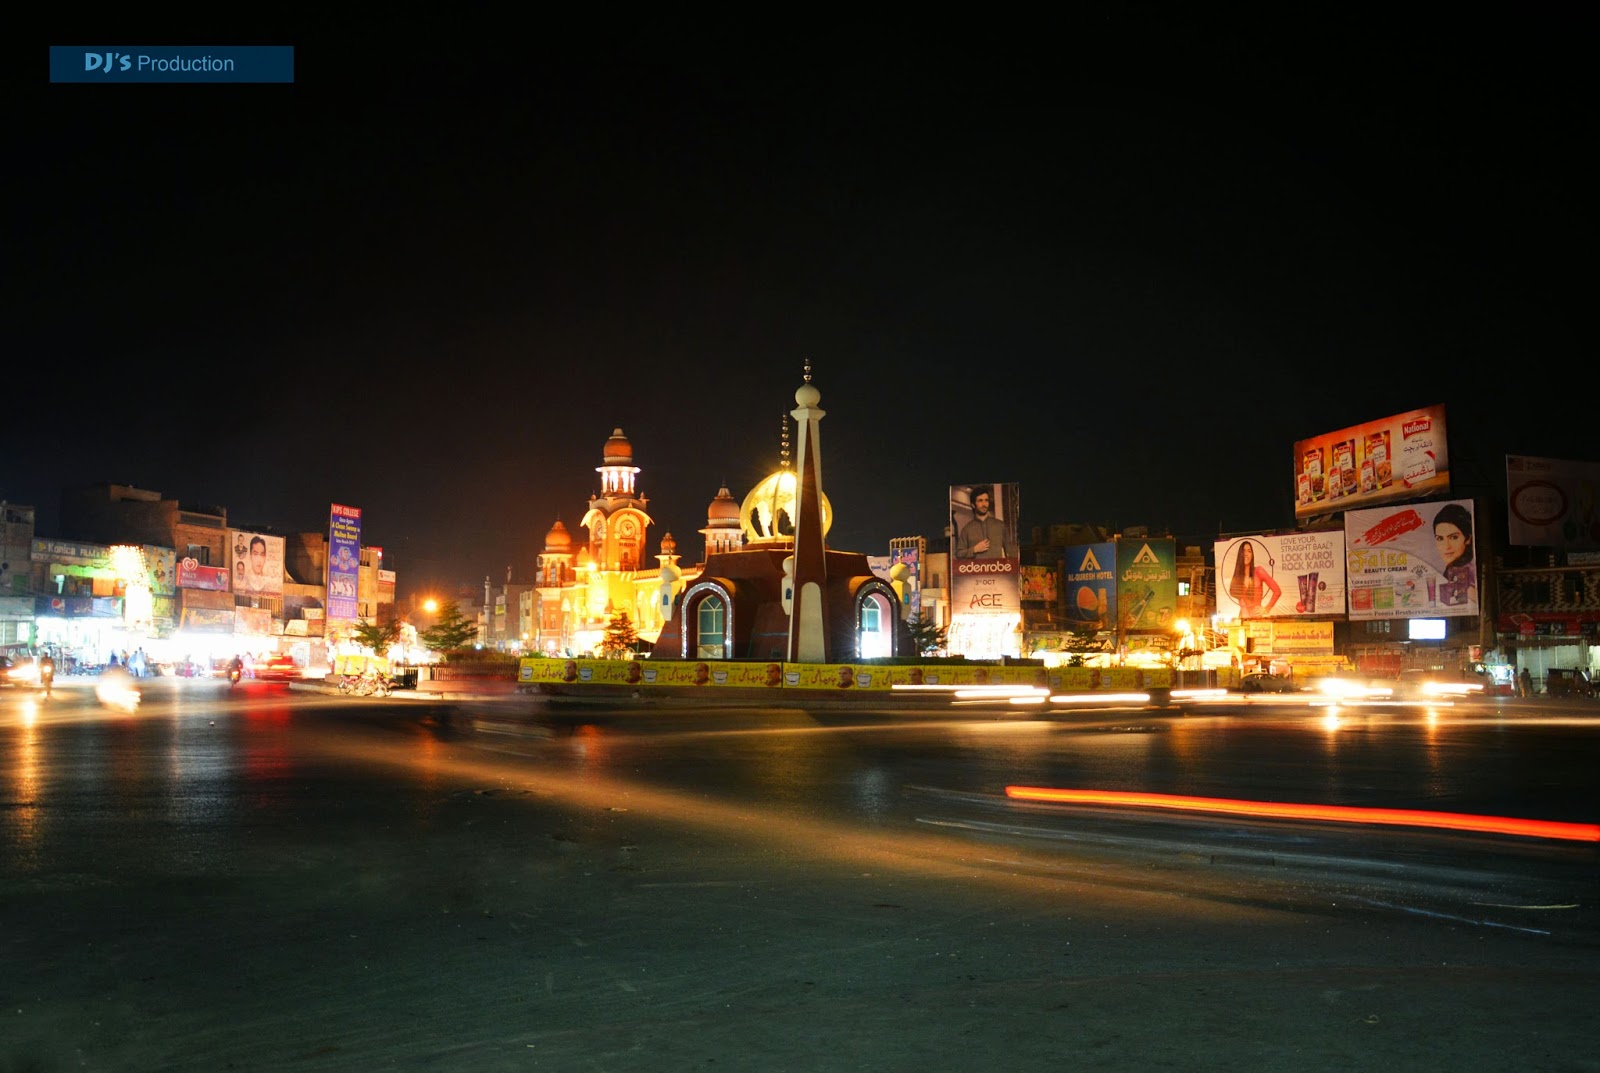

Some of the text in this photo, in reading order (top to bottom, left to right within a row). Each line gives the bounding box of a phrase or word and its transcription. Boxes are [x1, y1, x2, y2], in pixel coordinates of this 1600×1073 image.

[1404, 421, 1429, 434] National
[343, 507, 359, 518] COLLEGE
[1280, 536, 1316, 546] LOVE YOUR
[47, 542, 76, 556] Konica
[1280, 543, 1312, 553] STRAIGHT
[1281, 553, 1302, 562] LOCK
[958, 561, 1012, 573] edenrobe
[1281, 562, 1304, 571] ROCK
[1067, 571, 1114, 582] AL-QURESH HOTEL
[970, 593, 1003, 609] ACE
